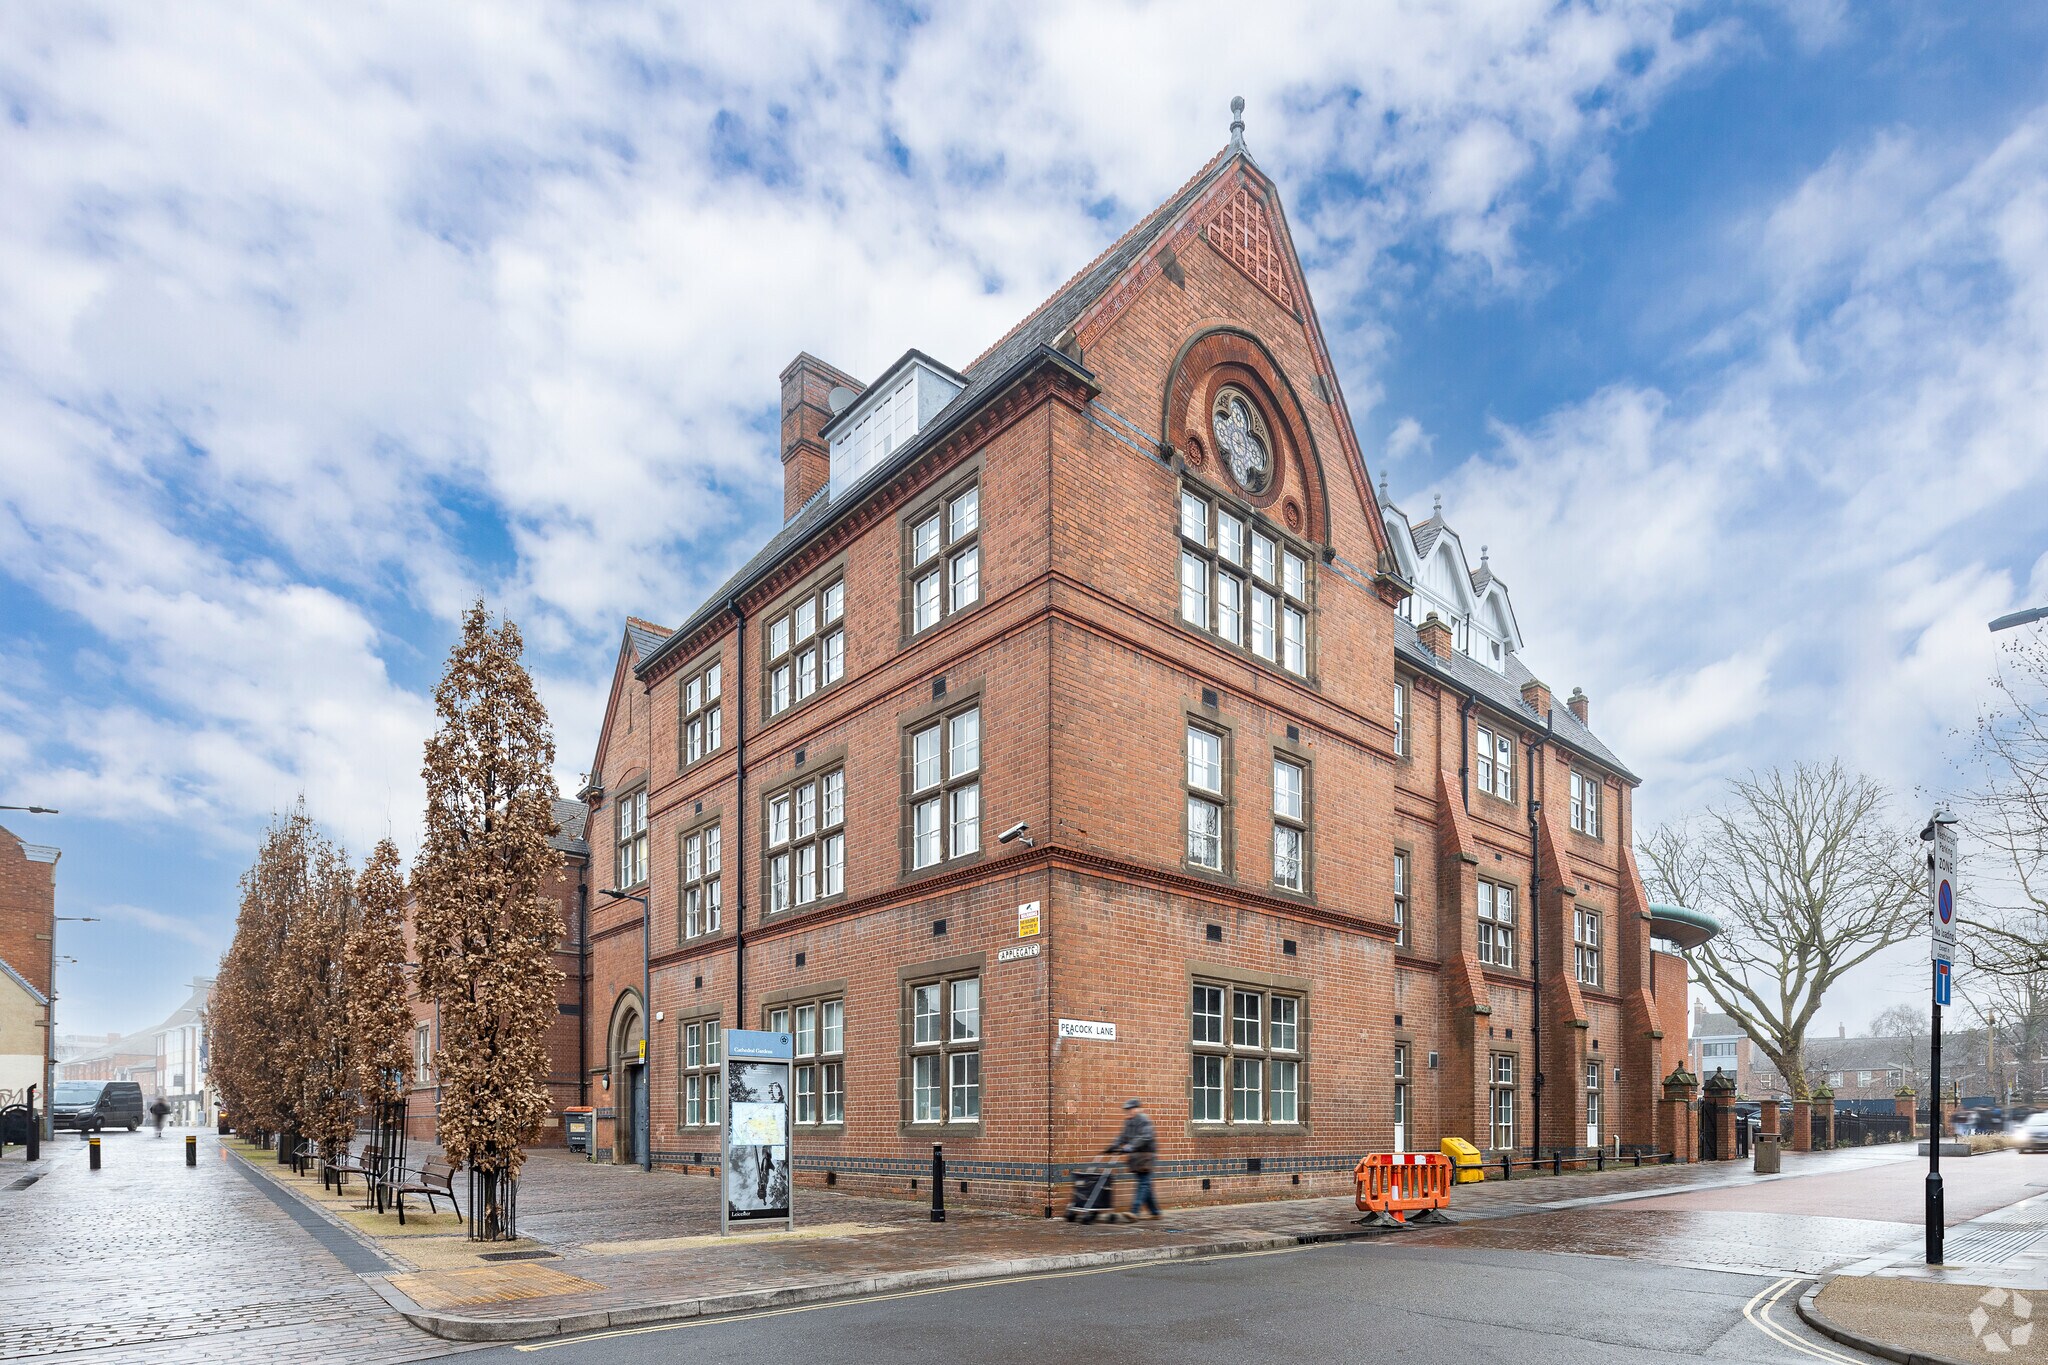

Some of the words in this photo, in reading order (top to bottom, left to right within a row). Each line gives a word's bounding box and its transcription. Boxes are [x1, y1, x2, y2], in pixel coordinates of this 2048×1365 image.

[1937, 828, 1956, 847] Restricted
[1939, 841, 1953, 858] Parking
[1939, 857, 1953, 875] ZONE
[1935, 925, 1941, 937] No
[1941, 928, 1954, 943] loading
[1001, 946, 1035, 959] APPLEGATE
[1061, 1023, 1093, 1034] PEACOCK
[1096, 1026, 1114, 1036] LANE
